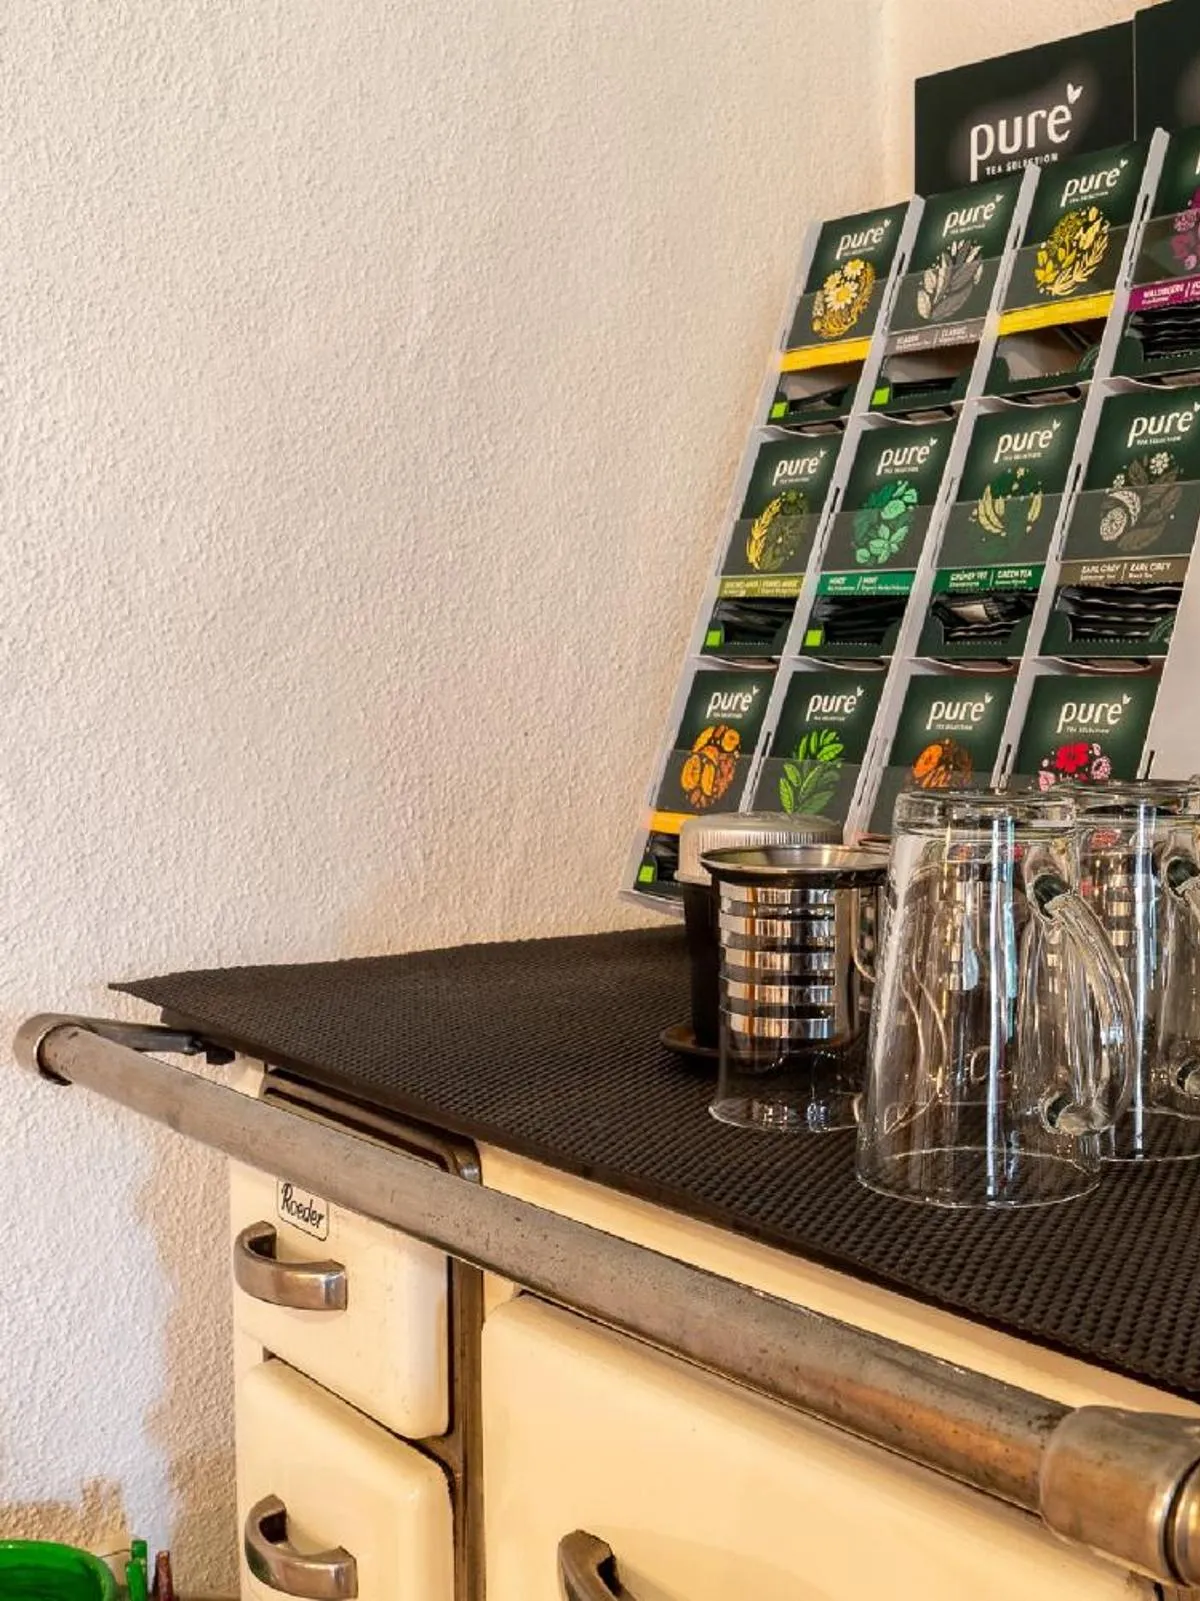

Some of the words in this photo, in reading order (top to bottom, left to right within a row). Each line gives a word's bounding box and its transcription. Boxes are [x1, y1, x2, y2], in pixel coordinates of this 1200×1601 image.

[970, 104, 1072, 182] pure
[985, 165, 1002, 175] TEA
[1060, 168, 1120, 208] pure
[943, 201, 996, 238] pure
[836, 227, 885, 260] pure
[1127, 411, 1194, 448] pure
[876, 446, 930, 476] pure
[993, 430, 1053, 463] pure
[772, 456, 819, 486] pure
[706, 691, 753, 719] pure
[805, 693, 857, 722] pure
[925, 700, 985, 730] pure
[1056, 702, 1123, 735] pure
[281, 1182, 325, 1229] Roeder
